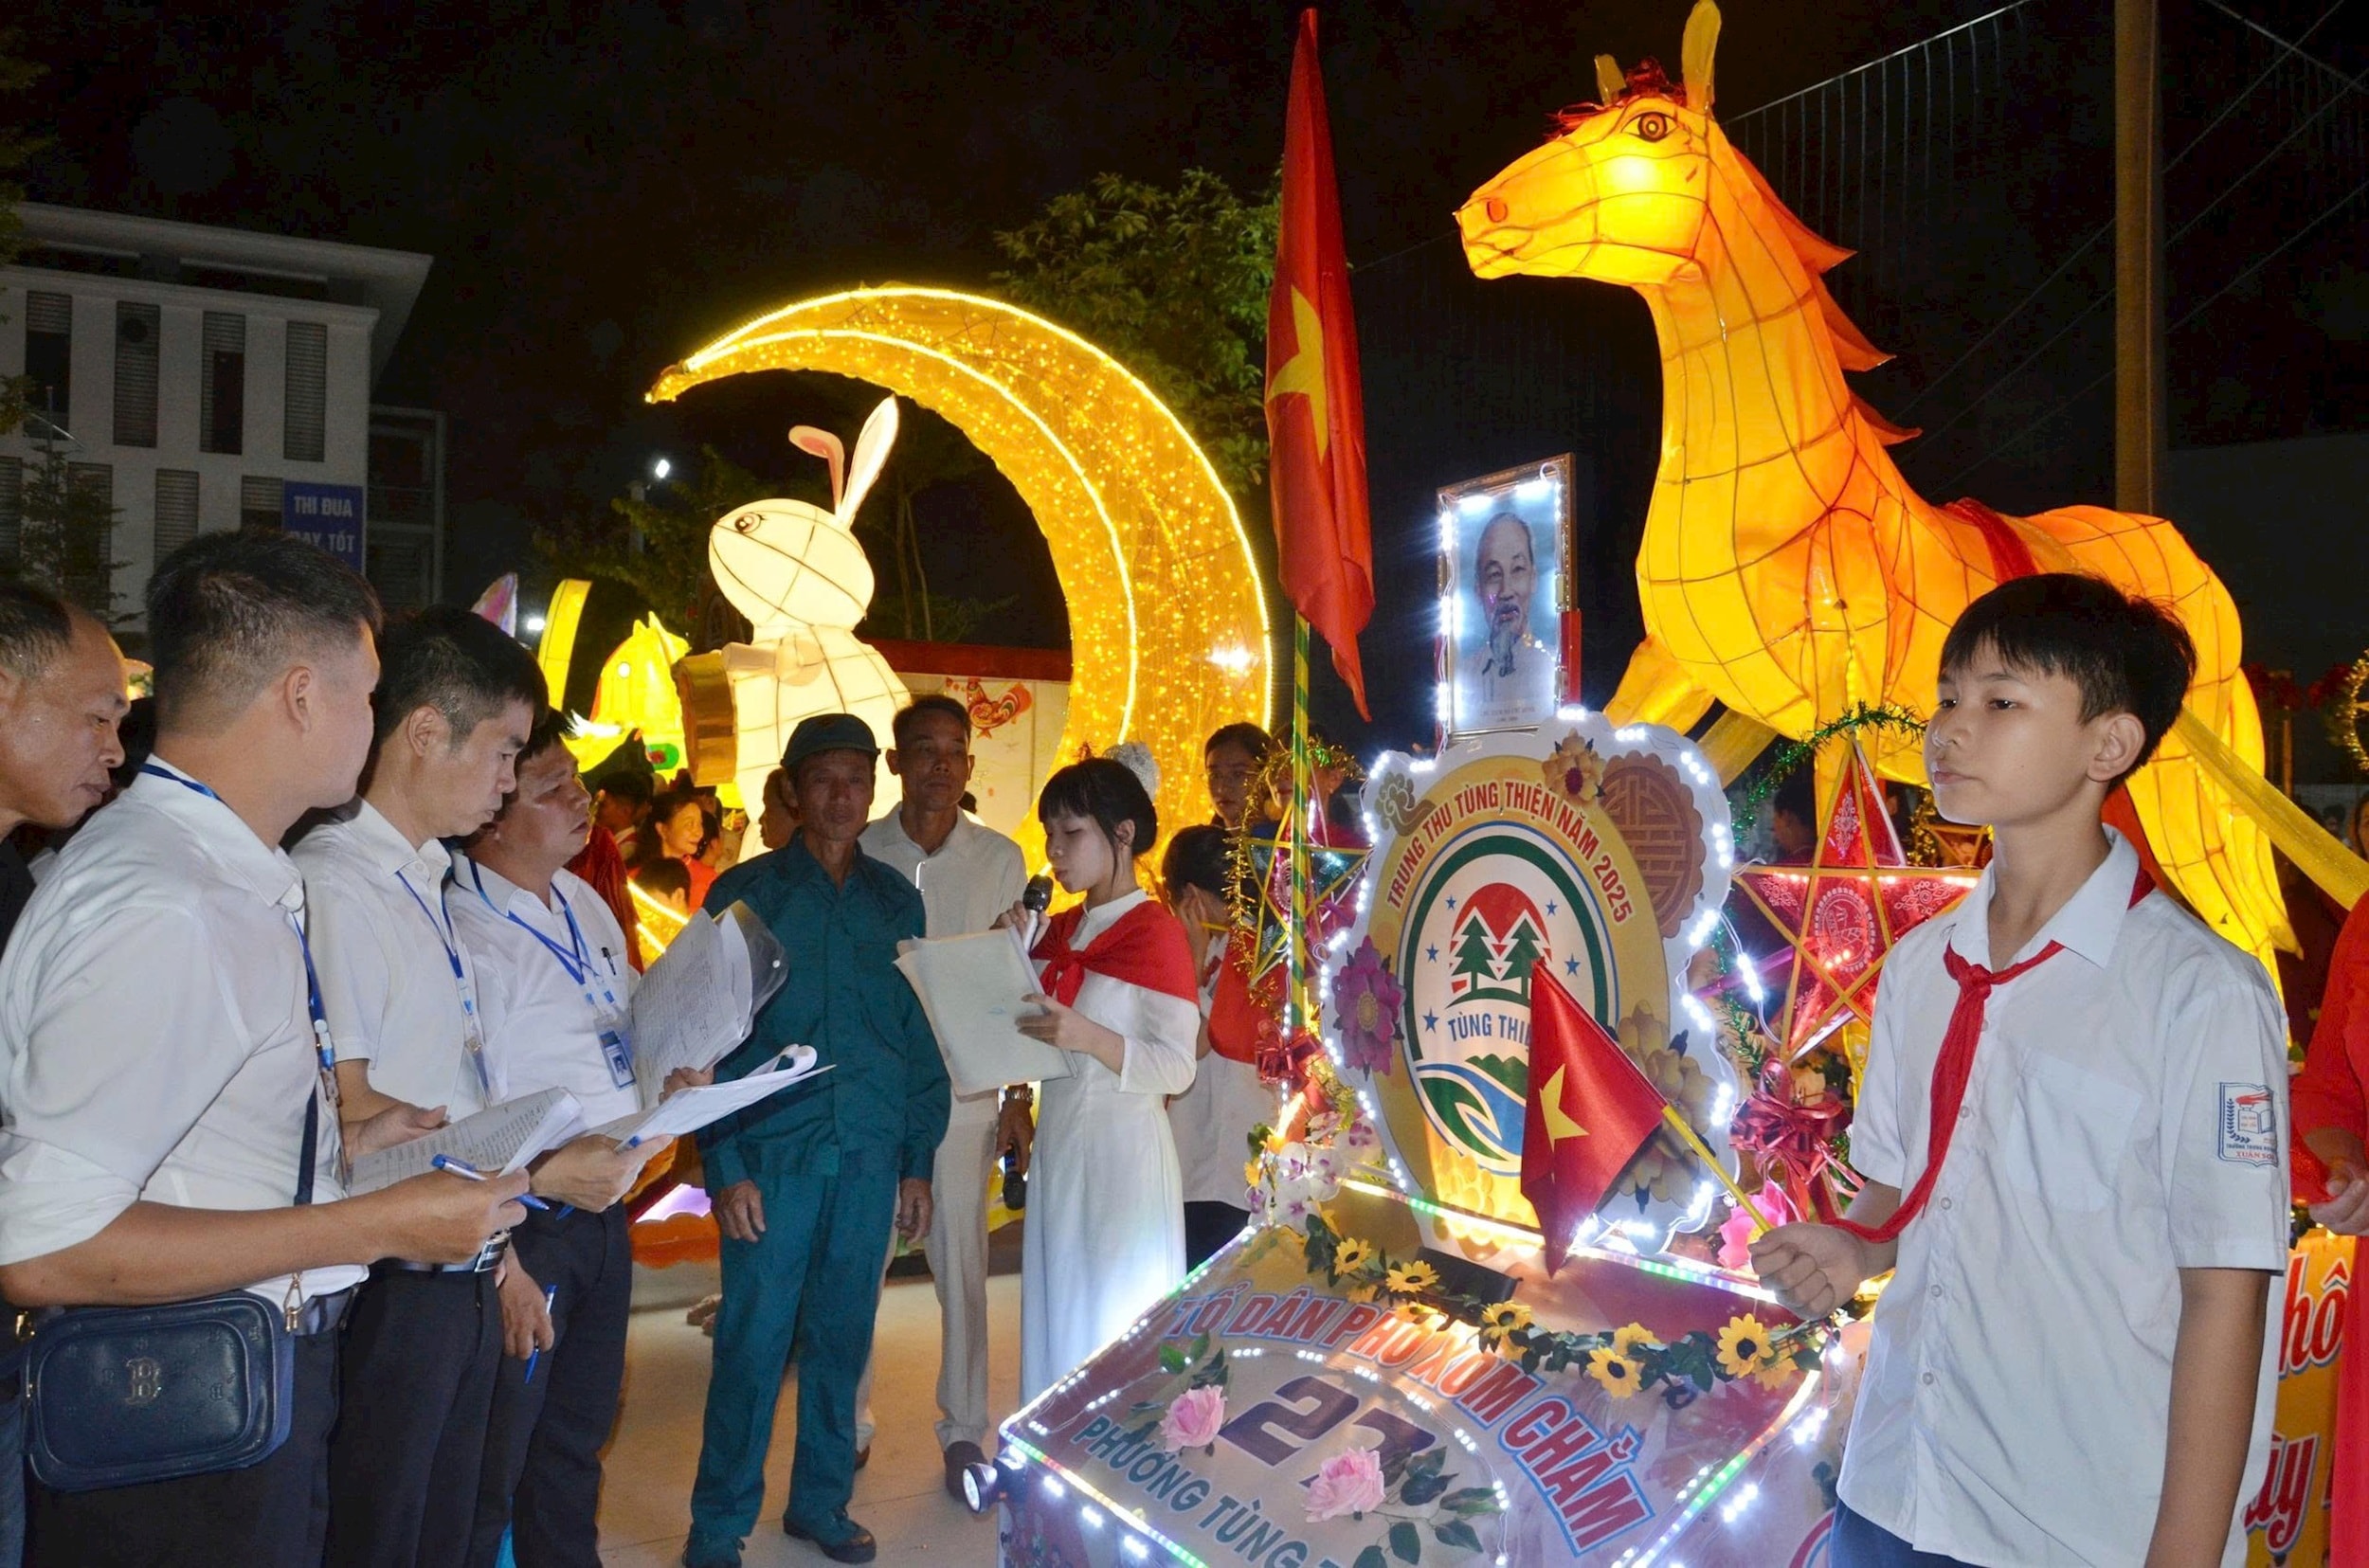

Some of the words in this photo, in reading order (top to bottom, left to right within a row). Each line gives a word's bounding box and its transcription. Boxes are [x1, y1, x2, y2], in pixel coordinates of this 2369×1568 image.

[294, 496, 317, 514] THI
[321, 497, 353, 517] ĐUA
[328, 529, 355, 552] TỐT
[1387, 836, 1426, 910] TRUNG
[1421, 803, 1454, 842] THU
[1455, 782, 1499, 819] TÙNG
[1505, 781, 1557, 821] THIỆN
[1556, 802, 1600, 861] NĂM
[1593, 855, 1634, 925] 2025
[1448, 1011, 1492, 1042] TÙNG
[1498, 1014, 1531, 1054] THI
[1167, 1282, 1251, 1338] TỔ
[1223, 1287, 1342, 1342] DÂN
[124, 1357, 162, 1406] B
[1198, 1494, 1310, 1568] TÙNG
